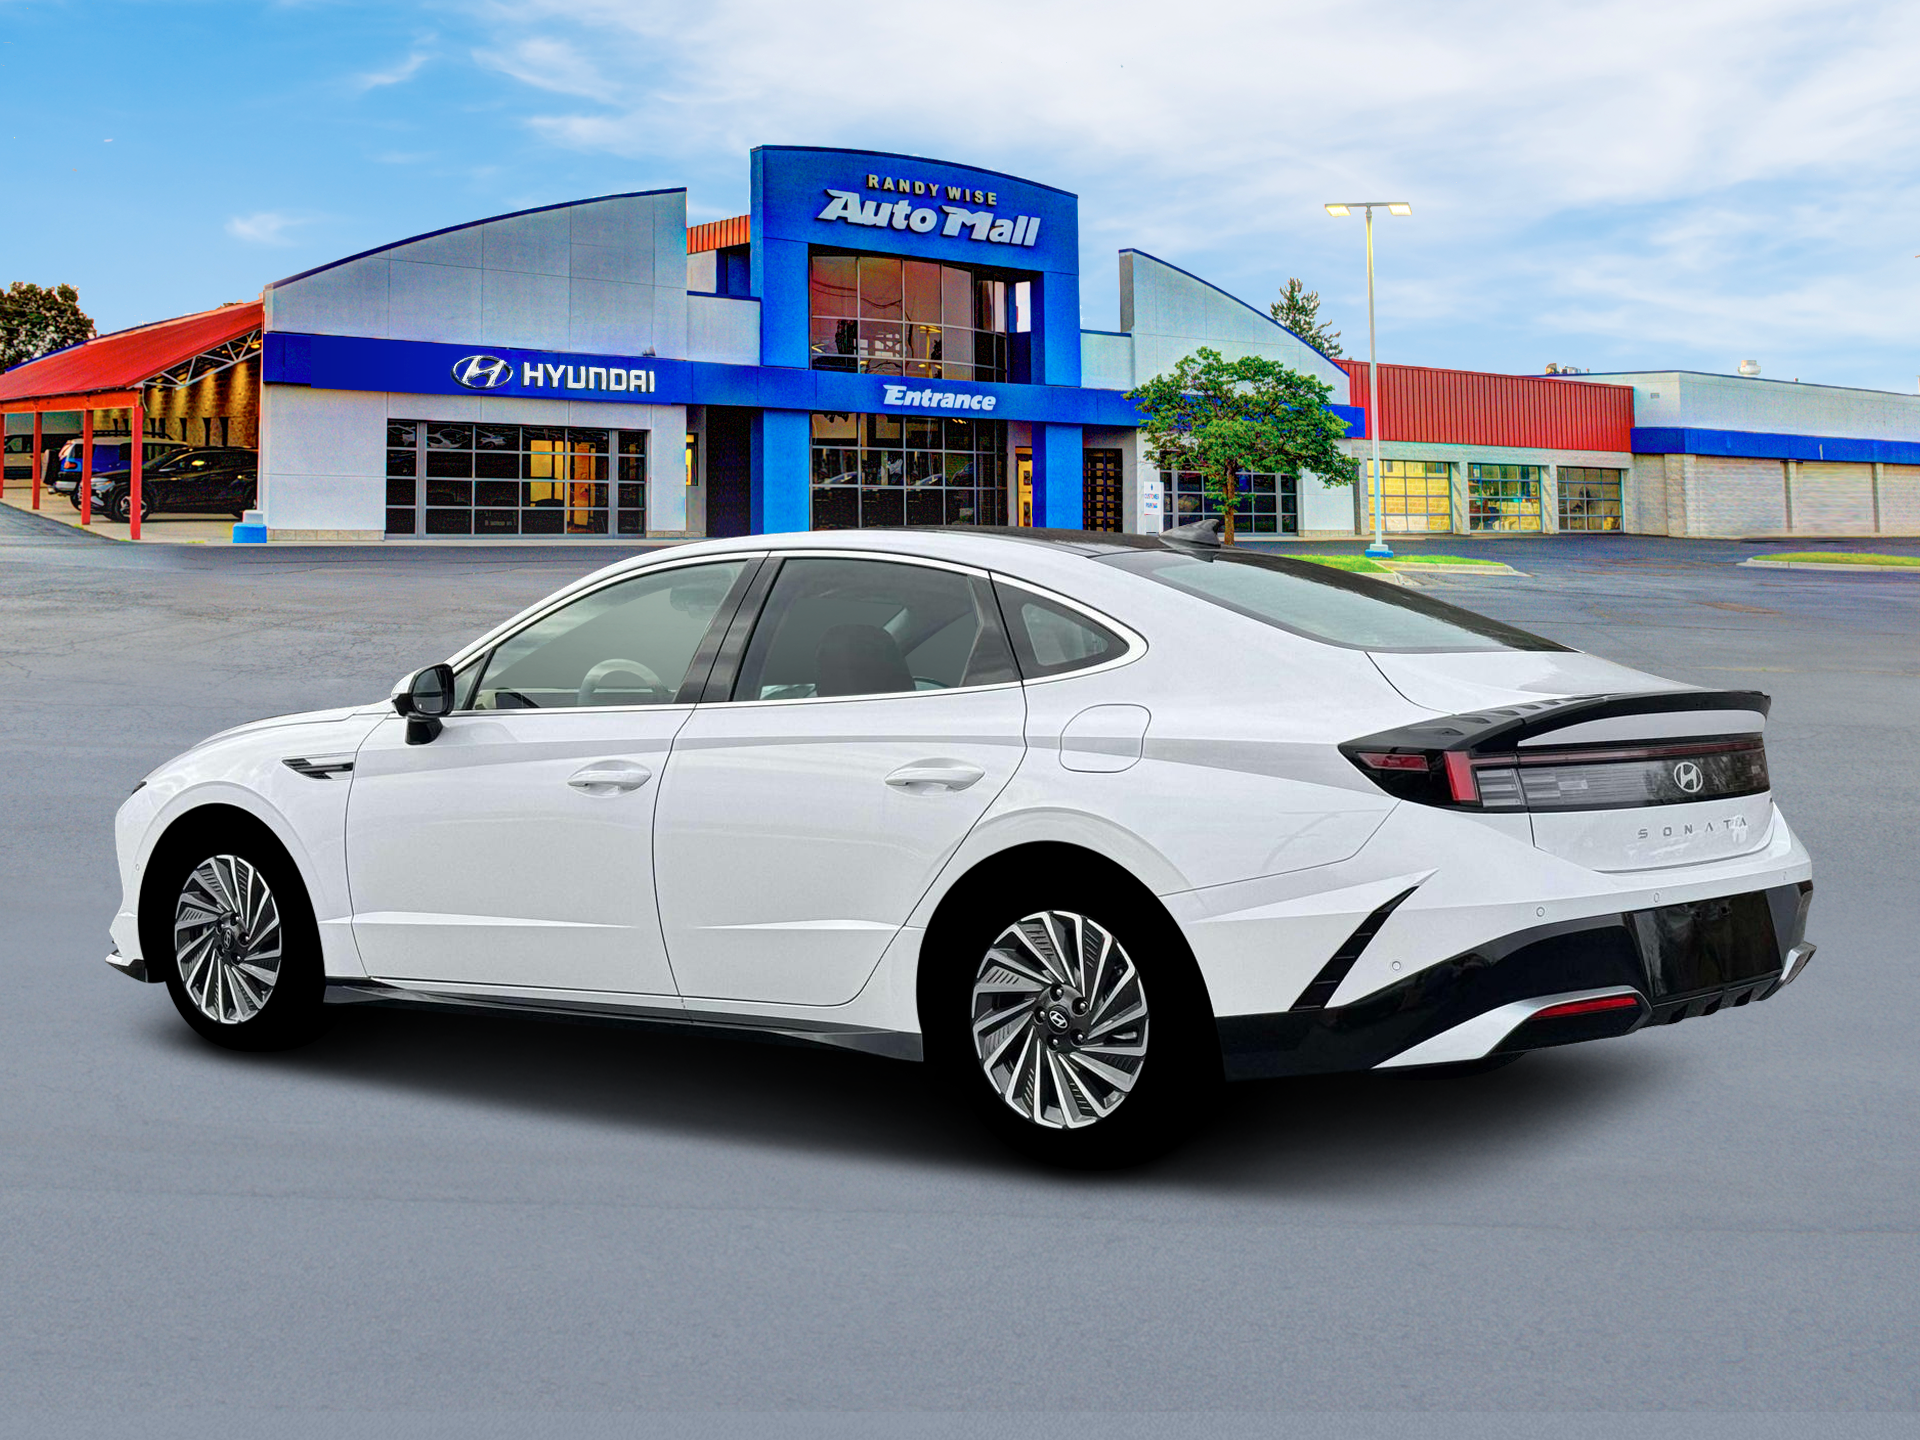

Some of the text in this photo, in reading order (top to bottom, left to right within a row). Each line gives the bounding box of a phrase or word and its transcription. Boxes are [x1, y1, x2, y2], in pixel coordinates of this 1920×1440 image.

[867, 173, 998, 206] RANDY WISE
[816, 188, 1042, 247] Auto Mall
[522, 362, 655, 393] HYUNDAI
[883, 384, 997, 411] Entrance
[1638, 817, 1747, 840] SONATA
